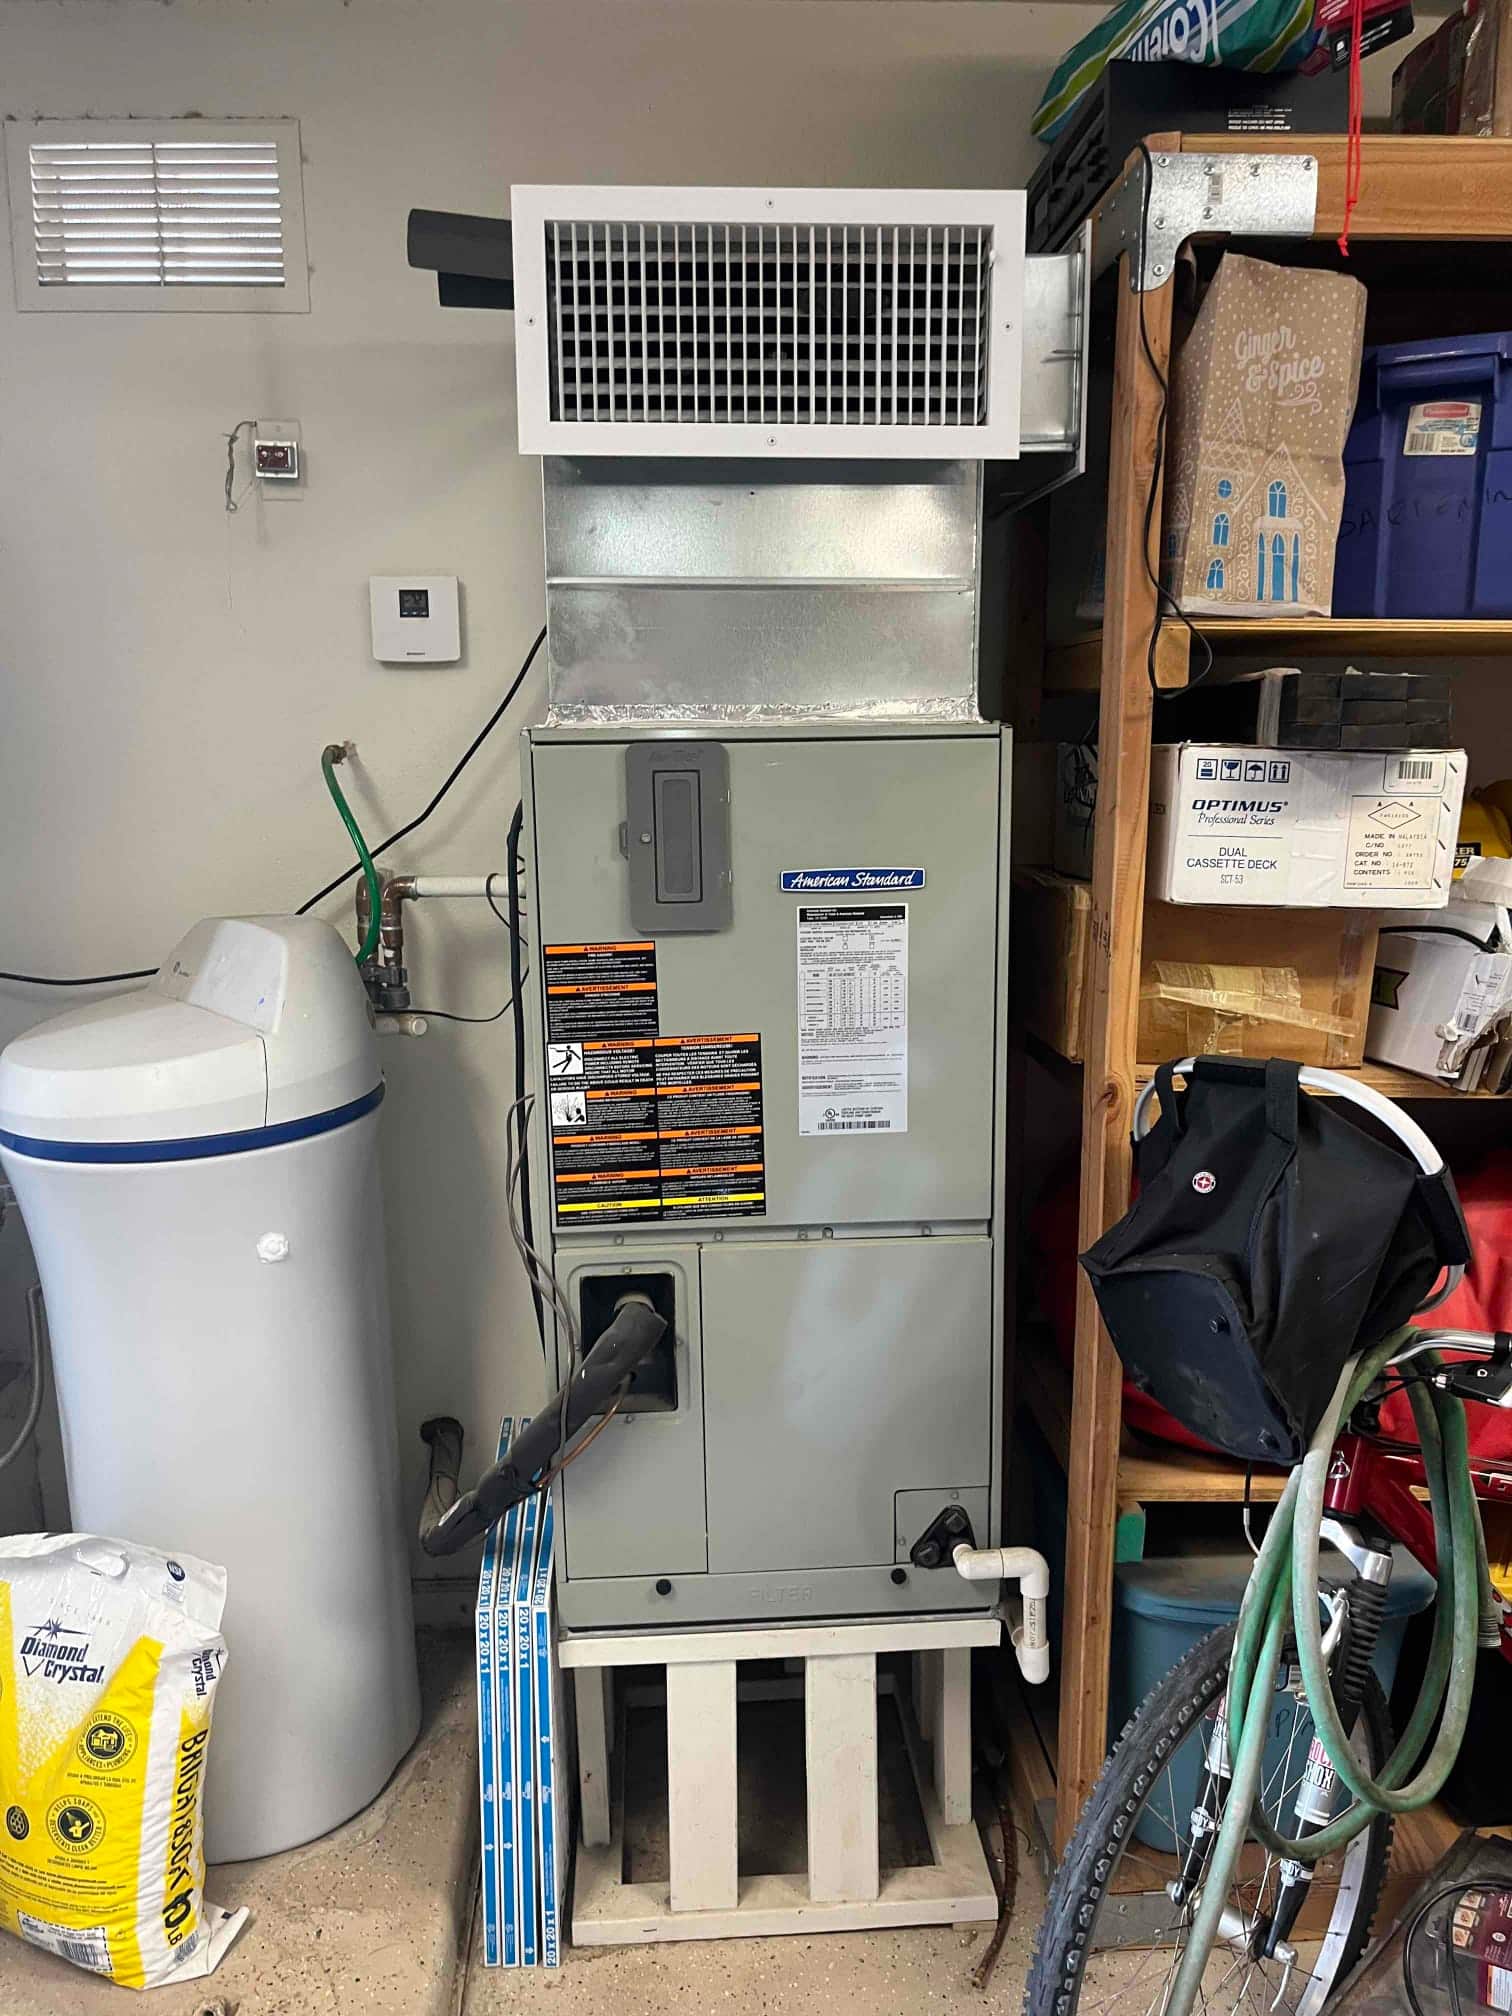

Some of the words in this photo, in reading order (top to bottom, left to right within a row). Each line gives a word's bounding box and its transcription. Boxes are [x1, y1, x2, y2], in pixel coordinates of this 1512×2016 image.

[1235, 326, 1296, 369] Ginger
[1268, 355, 1325, 396] Spice
[1192, 799, 1283, 812] OPTIMUS
[1198, 812, 1247, 827] Professional
[1249, 814, 1275, 825] Series
[1219, 847, 1247, 857] DUAL
[1186, 858, 1245, 869] CASSETTE
[1247, 859, 1278, 870] DECK
[791, 872, 850, 888] American
[851, 871, 917, 887] Standard
[480, 1614, 489, 1629] 20
[498, 1612, 507, 1627] 20
[520, 1608, 528, 1623] 20
[20, 1637, 88, 1663] Diamond
[481, 1640, 490, 1655] 20
[499, 1638, 508, 1653] 20
[520, 1635, 529, 1650] 20
[44, 1660, 105, 1684] Crystal
[192, 1658, 208, 1697] Crystal
[166, 1928, 184, 1947] LB
[546, 1926, 555, 1941] 20
[547, 1951, 556, 1965] 20
